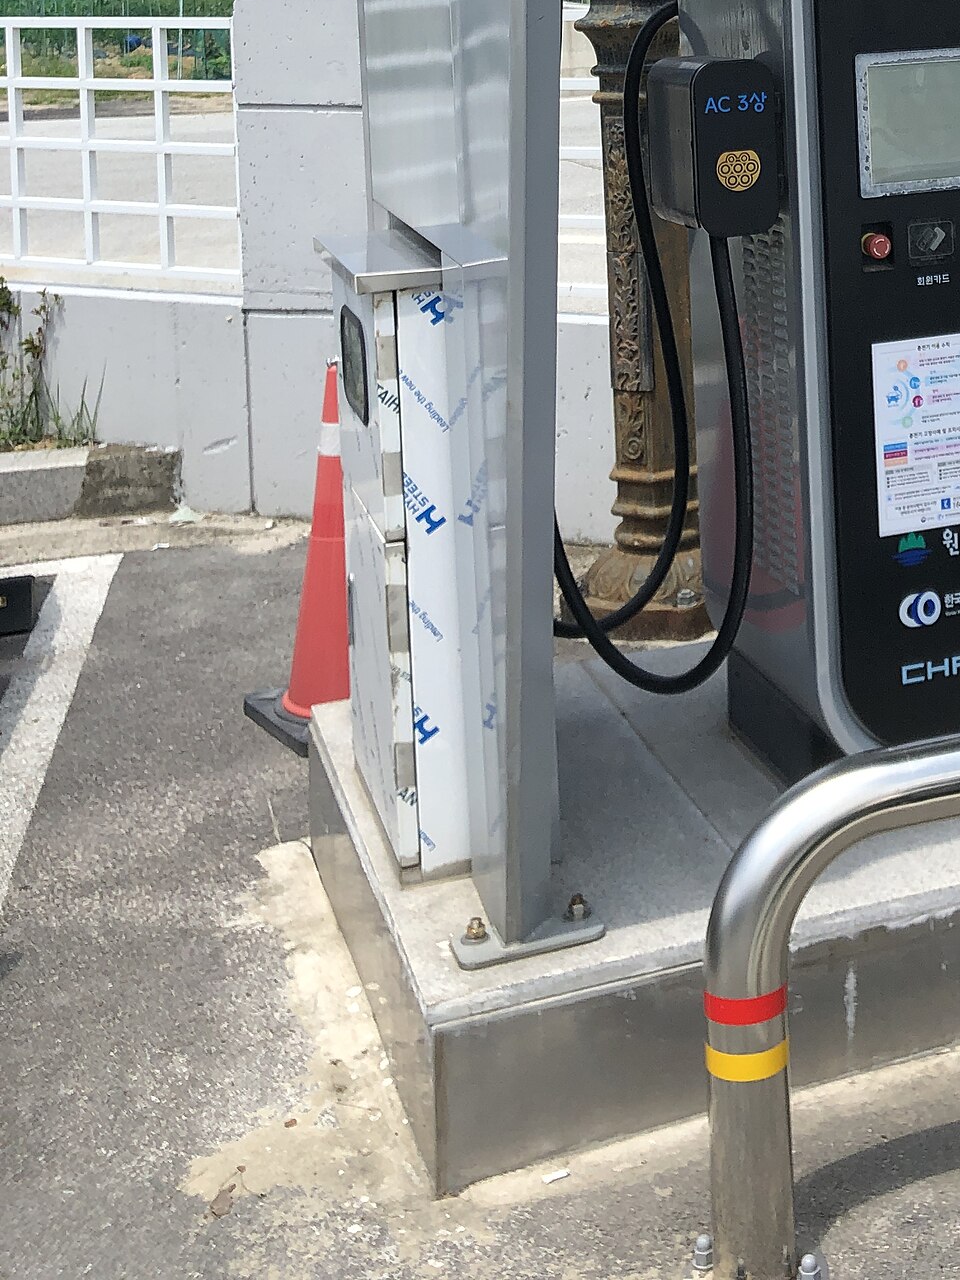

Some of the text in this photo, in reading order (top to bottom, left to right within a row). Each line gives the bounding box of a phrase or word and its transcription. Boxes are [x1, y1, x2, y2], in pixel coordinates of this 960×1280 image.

[704, 91, 768, 114] AC 3상
[916, 273, 950, 286] 회원카드
[414, 390, 426, 404] the
[424, 401, 450, 433] Leading
